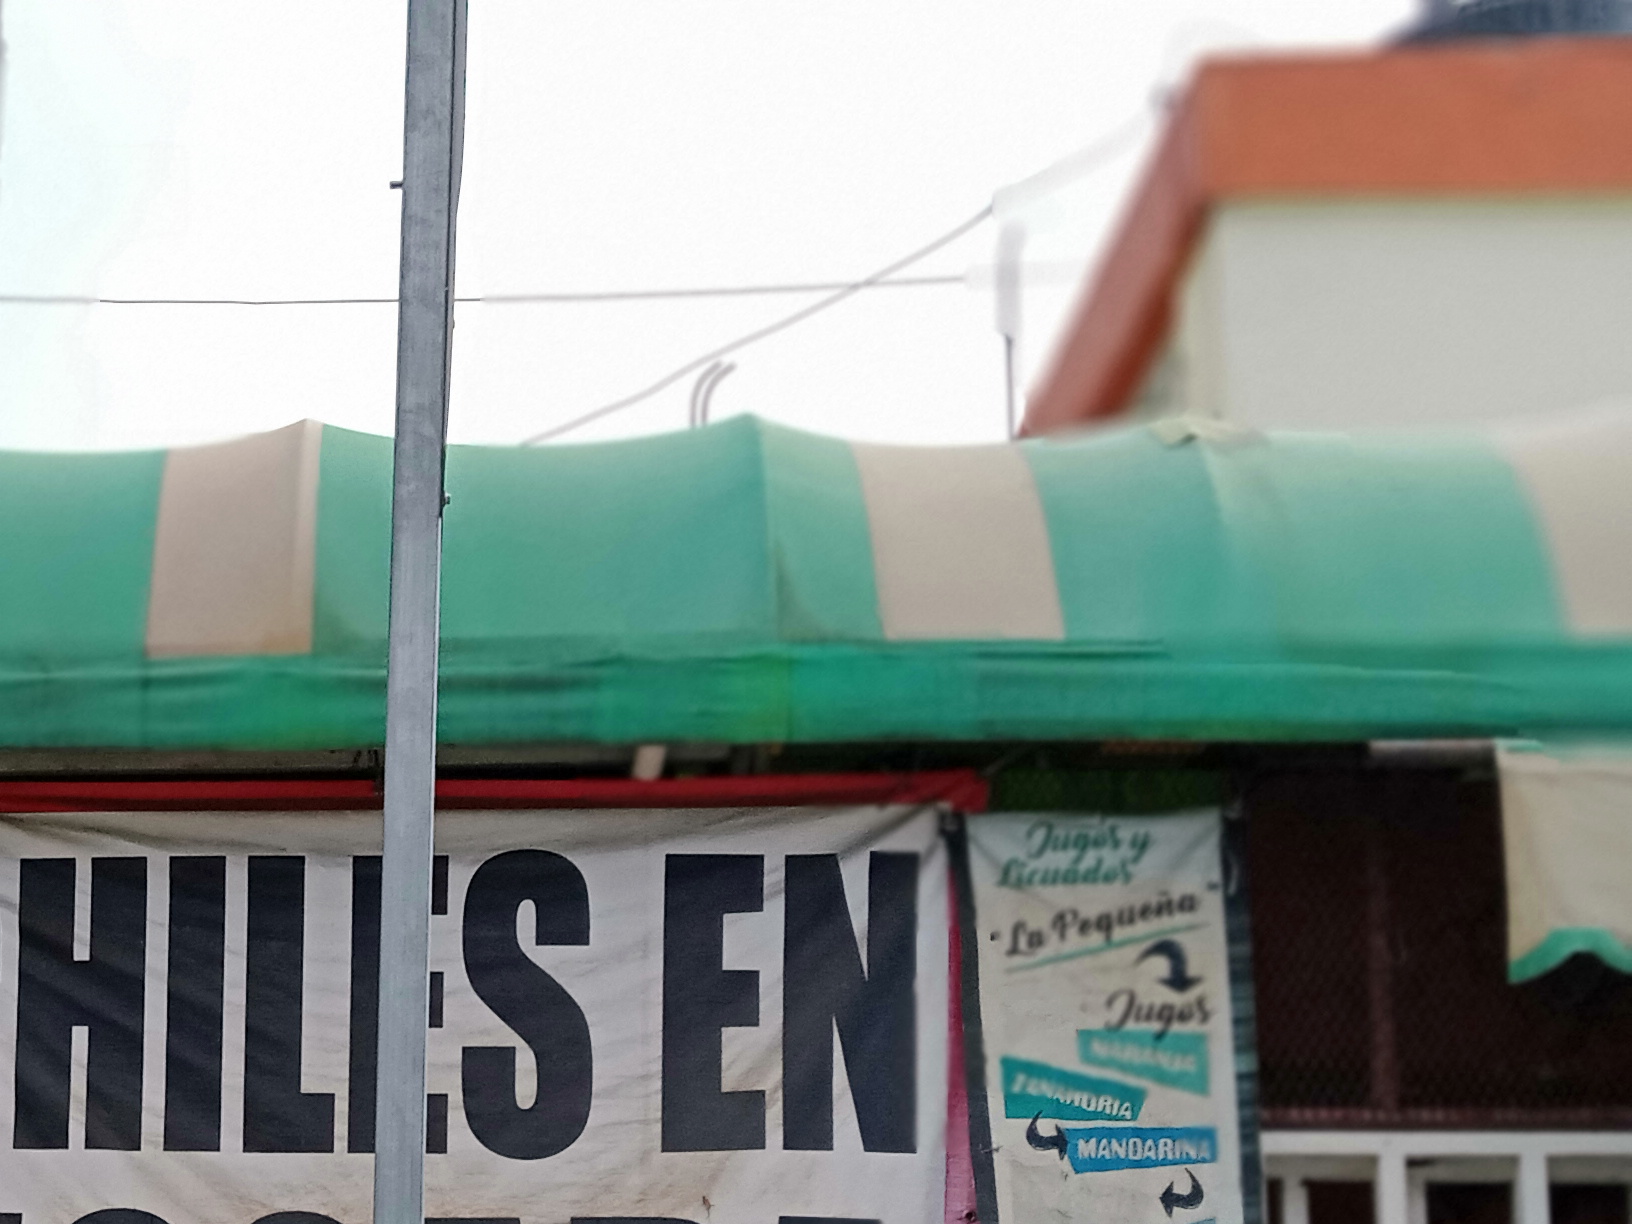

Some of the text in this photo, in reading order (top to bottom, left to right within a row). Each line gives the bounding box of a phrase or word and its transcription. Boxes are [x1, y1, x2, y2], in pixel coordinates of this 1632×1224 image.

[660, 850, 920, 1153] EN
[1103, 988, 1212, 1041] Jugos
[1077, 1136, 1212, 1161] MANDARINA
